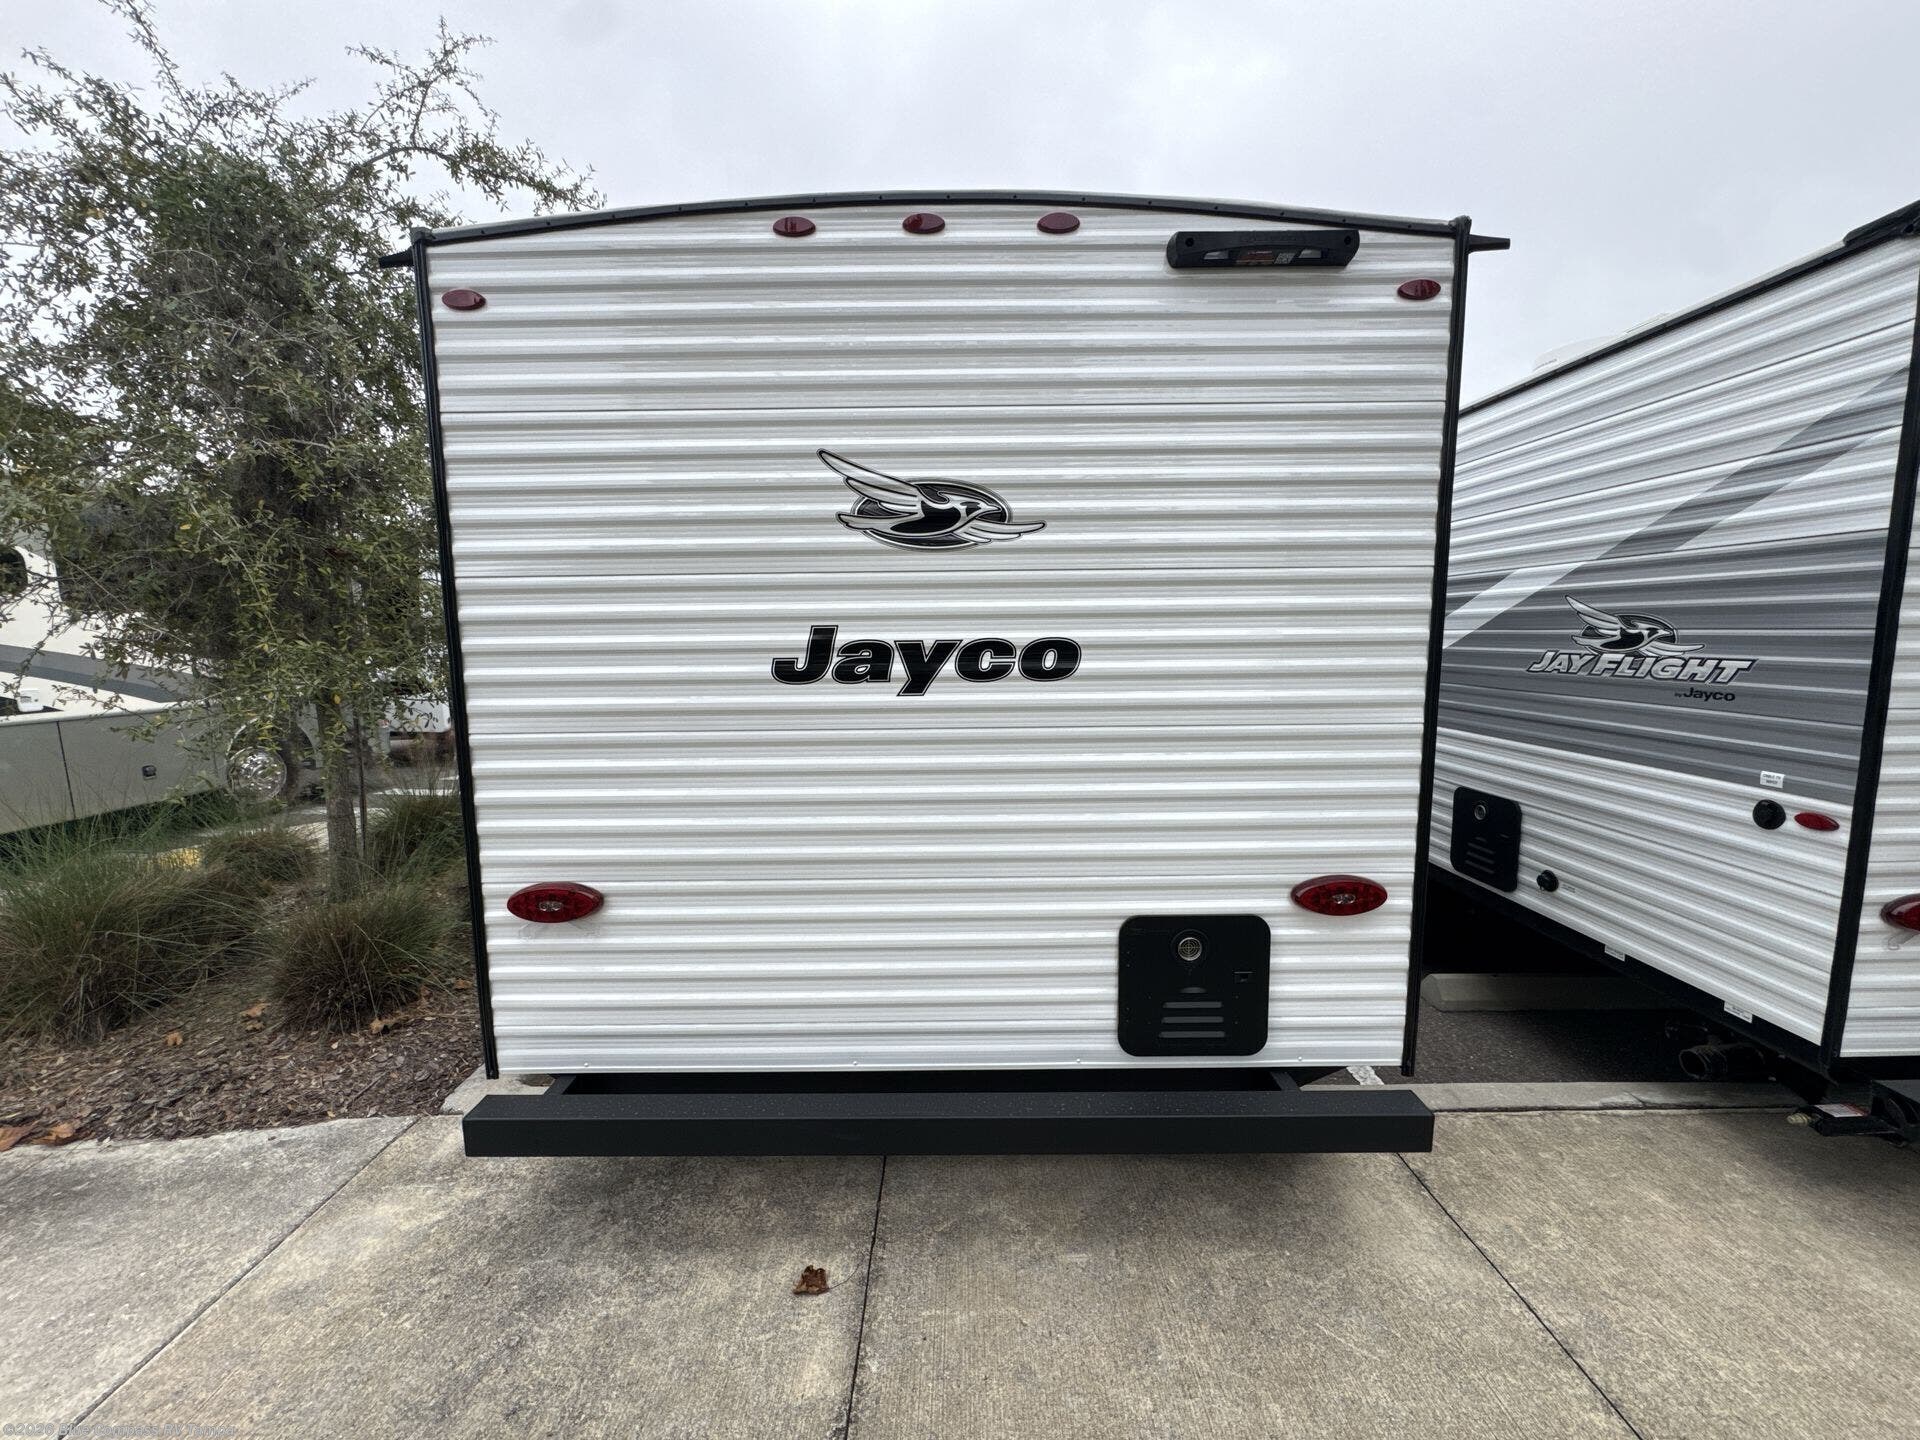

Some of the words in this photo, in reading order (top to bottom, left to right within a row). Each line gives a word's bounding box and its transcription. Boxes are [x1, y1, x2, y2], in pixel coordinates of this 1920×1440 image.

[772, 625, 1082, 696] Jayco
[1527, 651, 1594, 674] JAY
[1589, 653, 1757, 684] FLIGHT
[1683, 687, 1735, 702] Jayco
